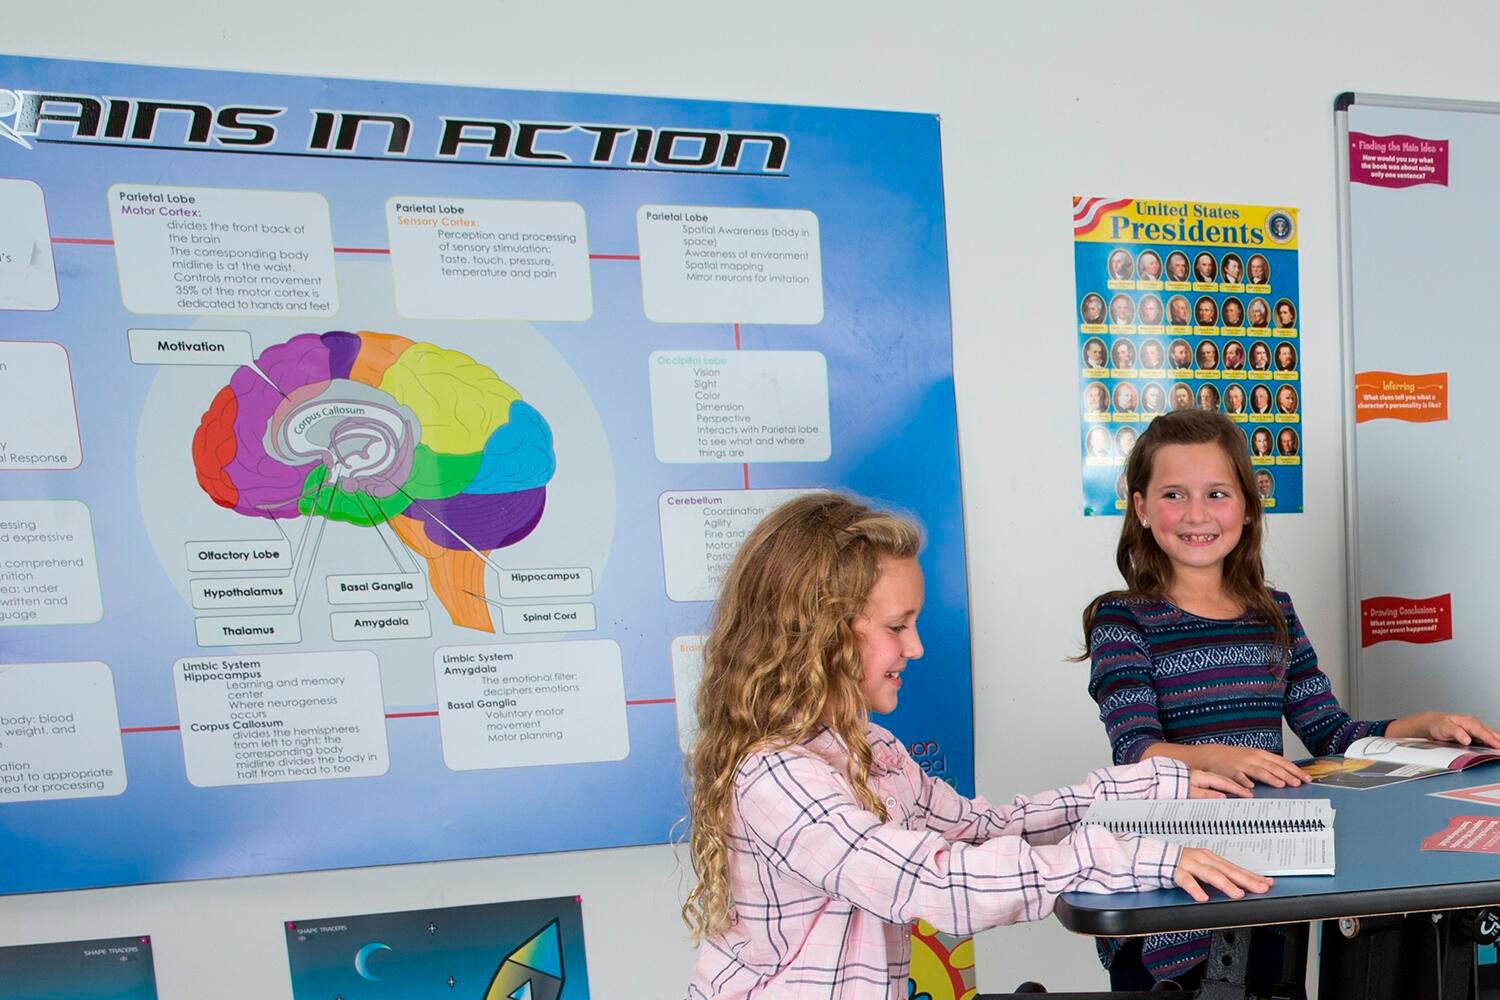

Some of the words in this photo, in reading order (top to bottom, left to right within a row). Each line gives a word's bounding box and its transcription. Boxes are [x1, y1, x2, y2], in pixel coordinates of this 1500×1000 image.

[310, 107, 413, 155] IN
[437, 115, 790, 172] ACTION
[1358, 140, 1386, 154] Finding
[1388, 141, 1401, 151] the
[1402, 142, 1419, 152] Main
[1420, 142, 1437, 153] Idea
[119, 192, 164, 202] Parietal
[167, 194, 196, 204] Lobe
[122, 205, 155, 215] Motor
[159, 207, 201, 217] Cortex:
[396, 204, 436, 213] Parietal
[439, 205, 464, 214] Lobe
[1137, 202, 1188, 217] United
[1193, 205, 1240, 219] States
[397, 216, 438, 226] Sensory
[441, 217, 479, 227] Cortex:
[646, 212, 682, 221] Parietal
[685, 213, 708, 222] Lobe
[166, 220, 208, 230] divides
[210, 222, 229, 232] the
[232, 222, 258, 232] front
[261, 224, 291, 234] back
[294, 225, 304, 234] of
[682, 225, 715, 235] Spatial
[718, 227, 769, 236] Awareness
[772, 227, 799, 238] (body
[801, 229, 810, 237] in
[1110, 216, 1264, 246] Presidents
[168, 233, 188, 243] the
[191, 234, 221, 244] brain
[437, 229, 496, 240] Perception
[498, 232, 519, 240] and
[522, 234, 577, 244] processing
[438, 242, 450, 251] of
[452, 244, 491, 253] sensory
[683, 238, 717, 247] space)
[170, 246, 191, 256] The
[193, 249, 277, 261] corresponding
[279, 250, 309, 261] body
[685, 249, 736, 258] Awareness
[738, 250, 748, 259] of
[750, 251, 809, 260] environment
[172, 260, 214, 270] midline
[216, 260, 224, 270] is
[226, 262, 239, 271] at
[242, 262, 261, 271] the
[685, 260, 718, 270] Spatial
[720, 263, 764, 272] mapping
[174, 272, 221, 283] Controls
[224, 275, 258, 284] motor
[261, 277, 321, 285] movement
[441, 268, 507, 277] temperature
[510, 269, 531, 278] and
[533, 269, 557, 278] pain
[686, 272, 713, 281] Mirror
[715, 274, 752, 282] neurons
[754, 273, 767, 283] for
[769, 274, 810, 283] imitation
[175, 285, 199, 295] 35%
[201, 286, 212, 295] of
[216, 286, 235, 296] the
[237, 288, 271, 297] motor
[274, 289, 310, 297] cortex
[312, 289, 319, 298] is
[177, 299, 235, 309] dedicated
[237, 300, 249, 309] to
[250, 301, 284, 310] hands
[285, 302, 307, 310] and
[309, 301, 330, 311] feet
[158, 341, 225, 351] Motivation
[693, 368, 720, 377] Vision
[694, 380, 717, 390] Sight
[694, 391, 720, 400] Color
[696, 403, 744, 412] Dimension
[294, 410, 321, 435] Corpus
[322, 405, 366, 417] Callosum
[696, 414, 751, 423] Perspective
[697, 426, 738, 434] Interacts
[761, 425, 796, 434] Parietal
[798, 425, 819, 434] lobe
[10, 453, 68, 463] Response
[667, 497, 722, 505] Cerebellum
[702, 507, 765, 516] Coordination
[704, 519, 732, 528] Agility
[12, 534, 73, 543] expressive
[198, 551, 250, 560] Olfactory
[253, 550, 280, 559] Lobe
[4, 558, 84, 568] comprehend
[511, 573, 580, 583] Hippocampus
[341, 583, 369, 592] Basal
[371, 581, 413, 592] Ganglia
[204, 588, 283, 599] Hypothalamus
[523, 613, 551, 622] Spinal
[553, 612, 577, 620] Cord
[354, 618, 409, 628] Amygdala
[222, 627, 274, 635] Thalamus
[443, 654, 475, 663] Limbic
[478, 653, 513, 662] System
[183, 662, 218, 671] Limbic
[222, 661, 261, 670] System
[444, 665, 497, 676] Amygdala
[184, 672, 262, 682] Hippocampus
[447, 701, 474, 710] Basal
[477, 699, 516, 708] Ganglia
[190, 723, 230, 732] Corpus
[232, 720, 283, 729] Callosum
